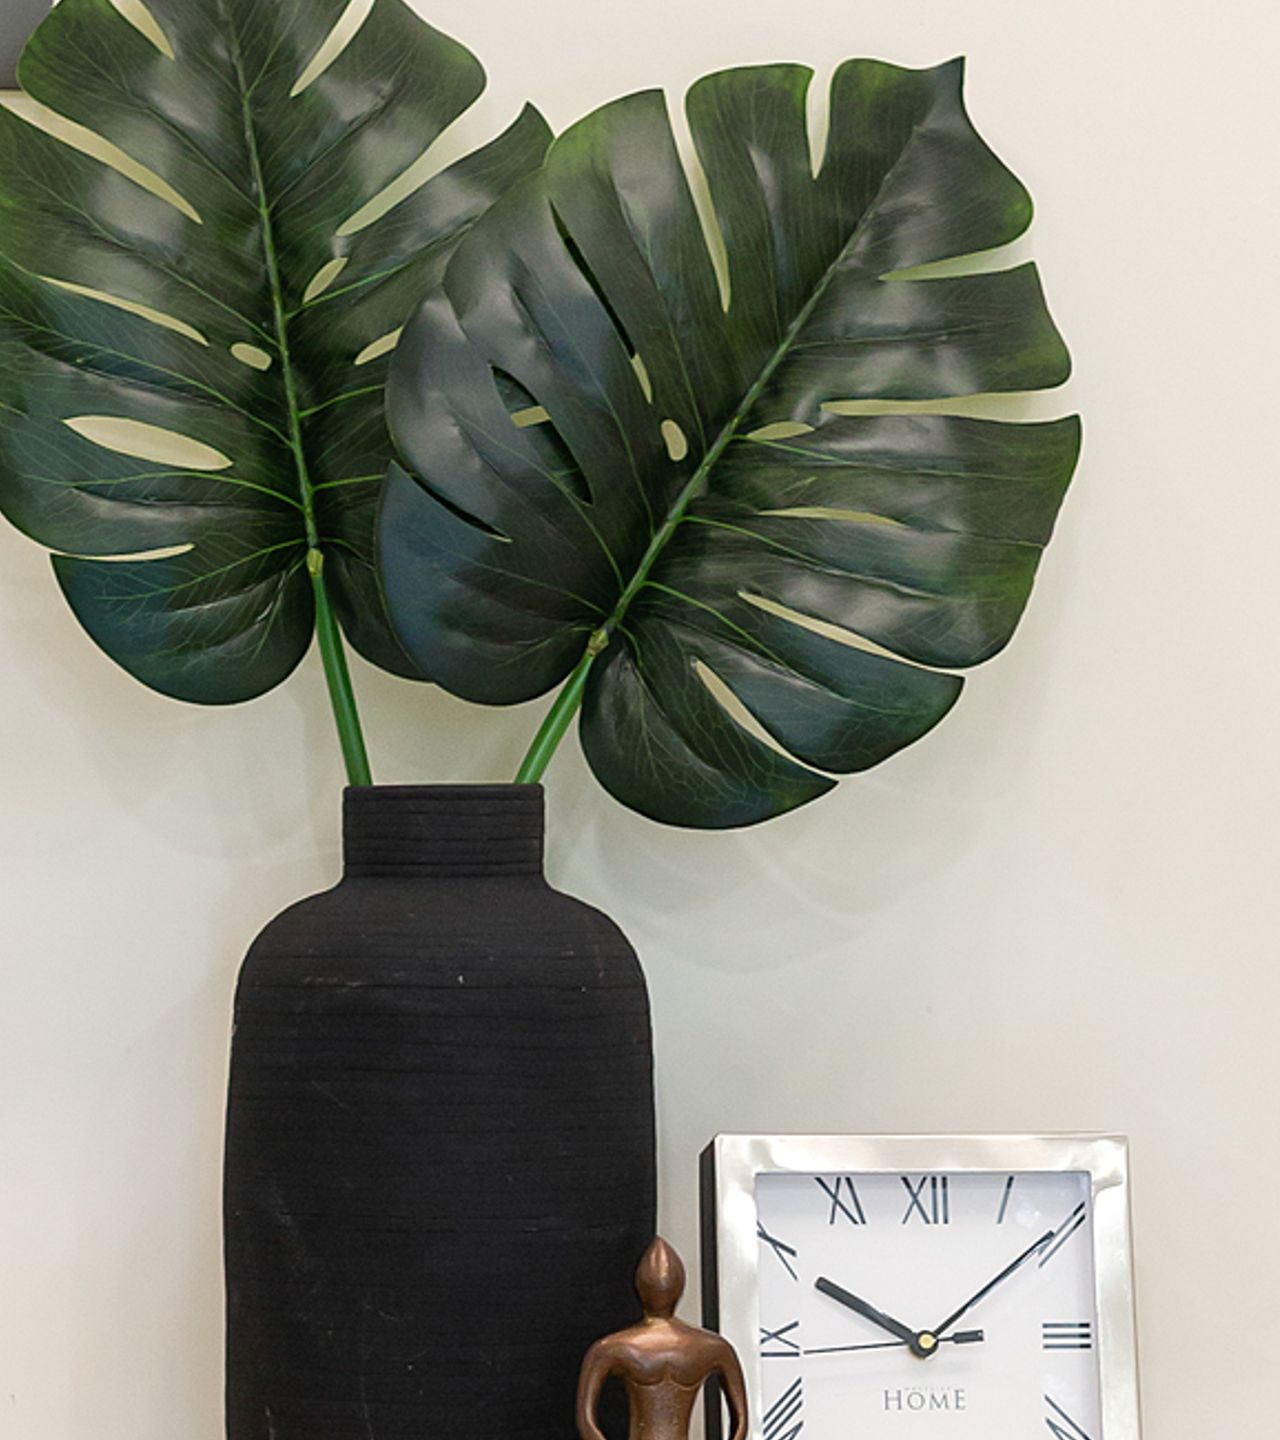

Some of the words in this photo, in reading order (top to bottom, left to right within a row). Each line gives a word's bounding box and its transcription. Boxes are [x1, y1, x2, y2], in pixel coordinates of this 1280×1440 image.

[814, 1176, 866, 1225] XI
[901, 1176, 949, 1225] XII
[1042, 1322, 1092, 1349] III
[884, 1389, 966, 1410] HOME
